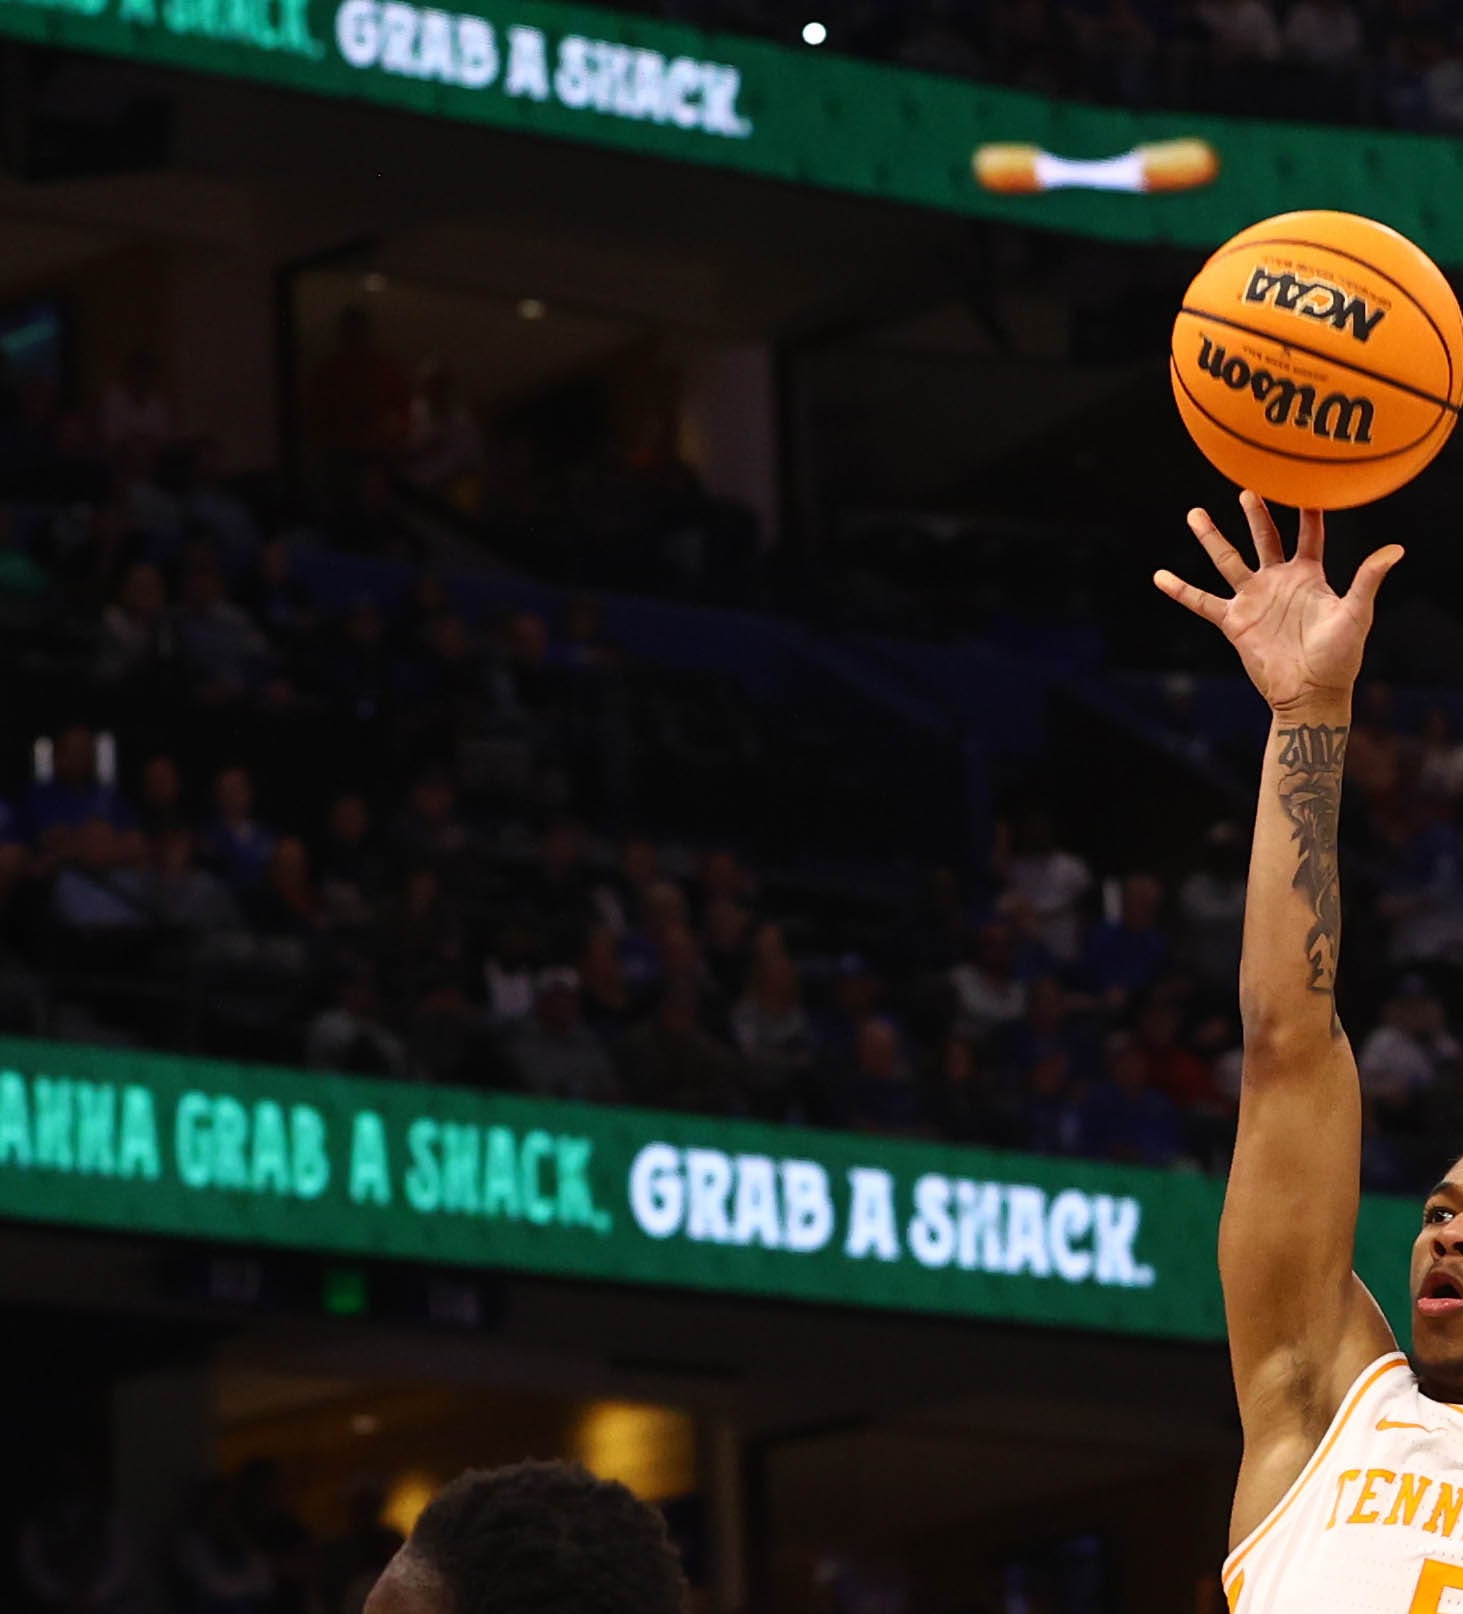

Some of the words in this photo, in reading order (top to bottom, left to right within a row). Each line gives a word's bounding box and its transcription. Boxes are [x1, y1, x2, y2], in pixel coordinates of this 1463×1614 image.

[336, 0, 499, 88] GRAB
[504, 26, 550, 101] A
[1244, 266, 1385, 344] NCAA
[1196, 333, 1374, 444] Wilson
[174, 1090, 331, 1200] GRAB
[348, 1109, 394, 1205] A
[628, 1142, 834, 1254] GRAB
[845, 1166, 900, 1262] A
